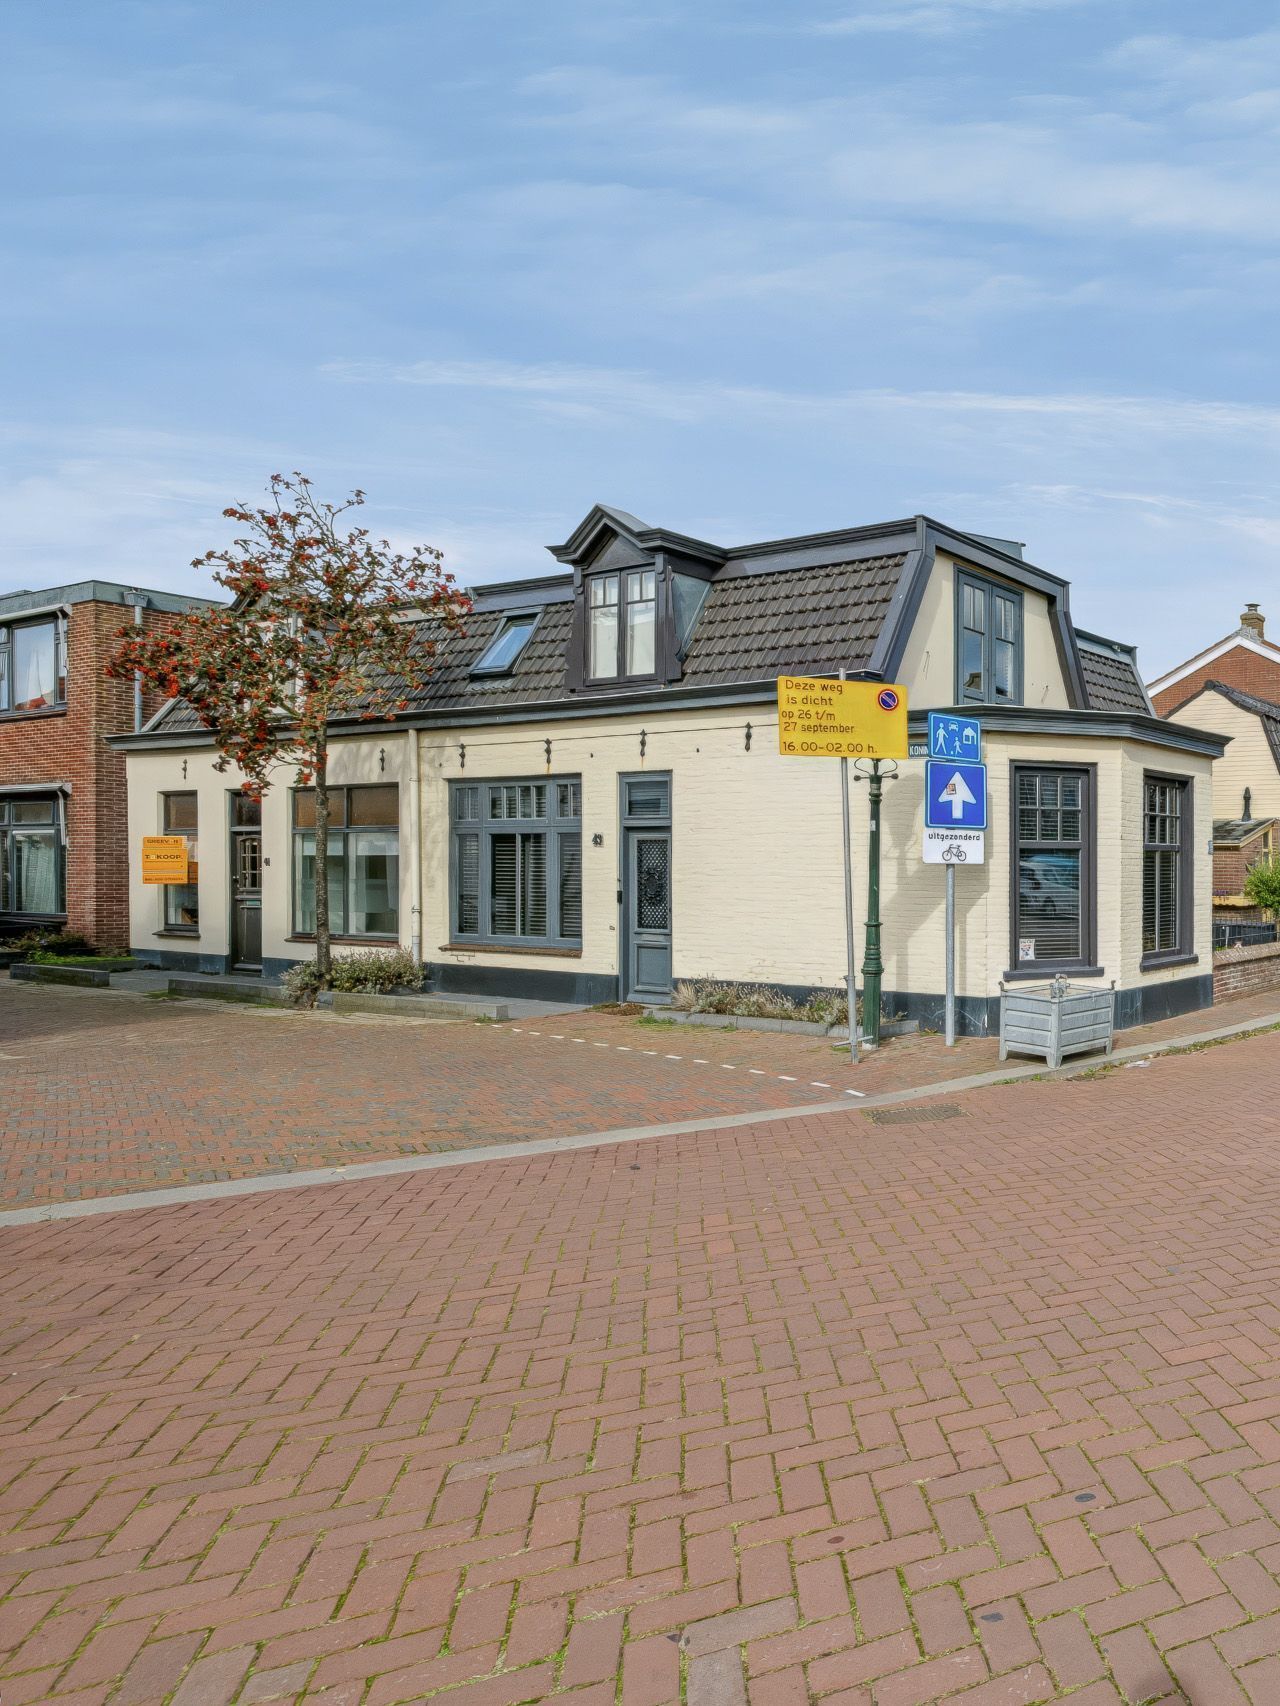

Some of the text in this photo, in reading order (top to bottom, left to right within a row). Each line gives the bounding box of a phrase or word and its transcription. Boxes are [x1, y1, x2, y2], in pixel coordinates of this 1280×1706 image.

[785, 679, 843, 695] Deze weg
[786, 694, 833, 706] is dicht
[781, 709, 836, 721] op 26 t/m
[783, 722, 855, 734] 27 september
[928, 832, 981, 842] uitgezonderd
